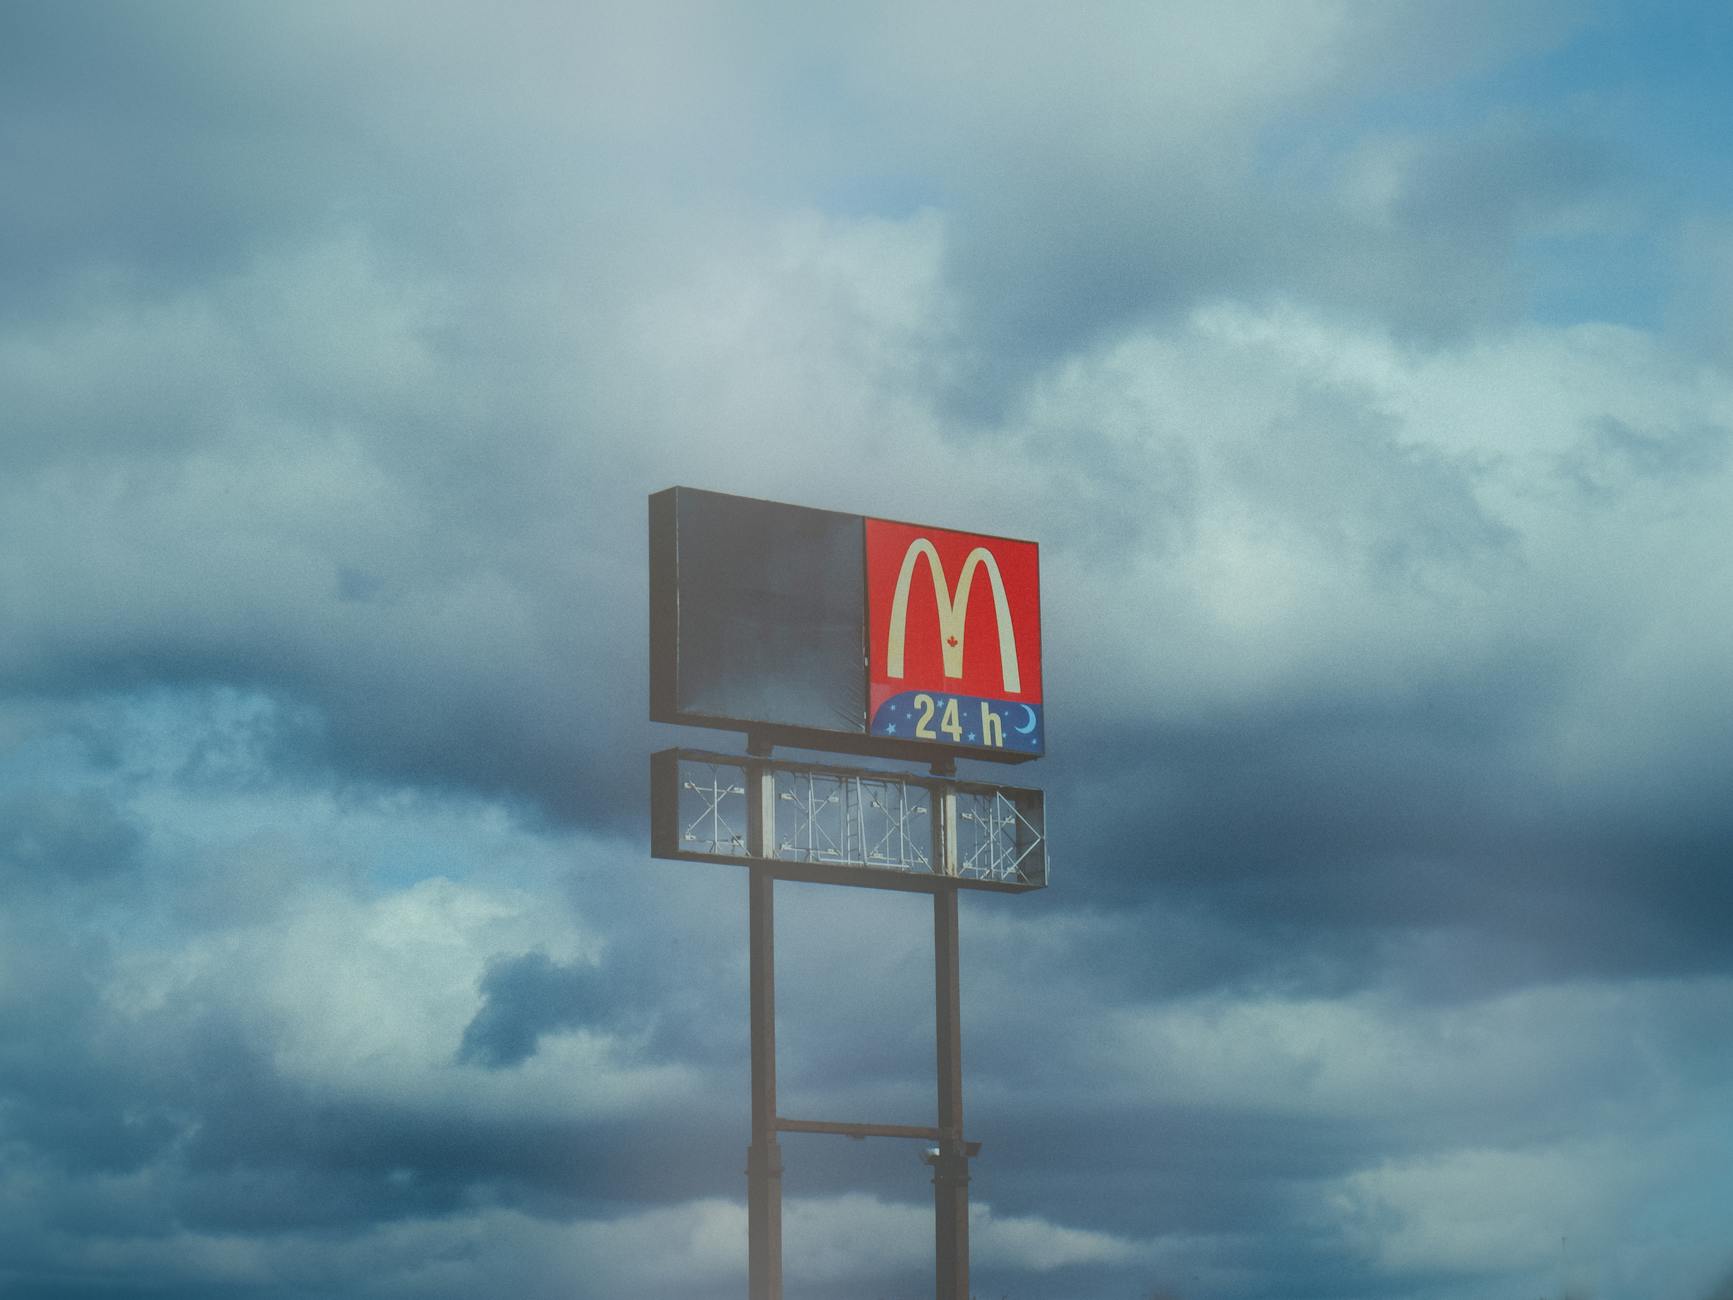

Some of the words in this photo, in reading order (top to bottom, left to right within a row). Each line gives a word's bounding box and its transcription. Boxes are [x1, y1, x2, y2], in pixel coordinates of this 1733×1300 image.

[887, 537, 1021, 693] M
[914, 694, 962, 742] 24
[981, 702, 1003, 747] h
